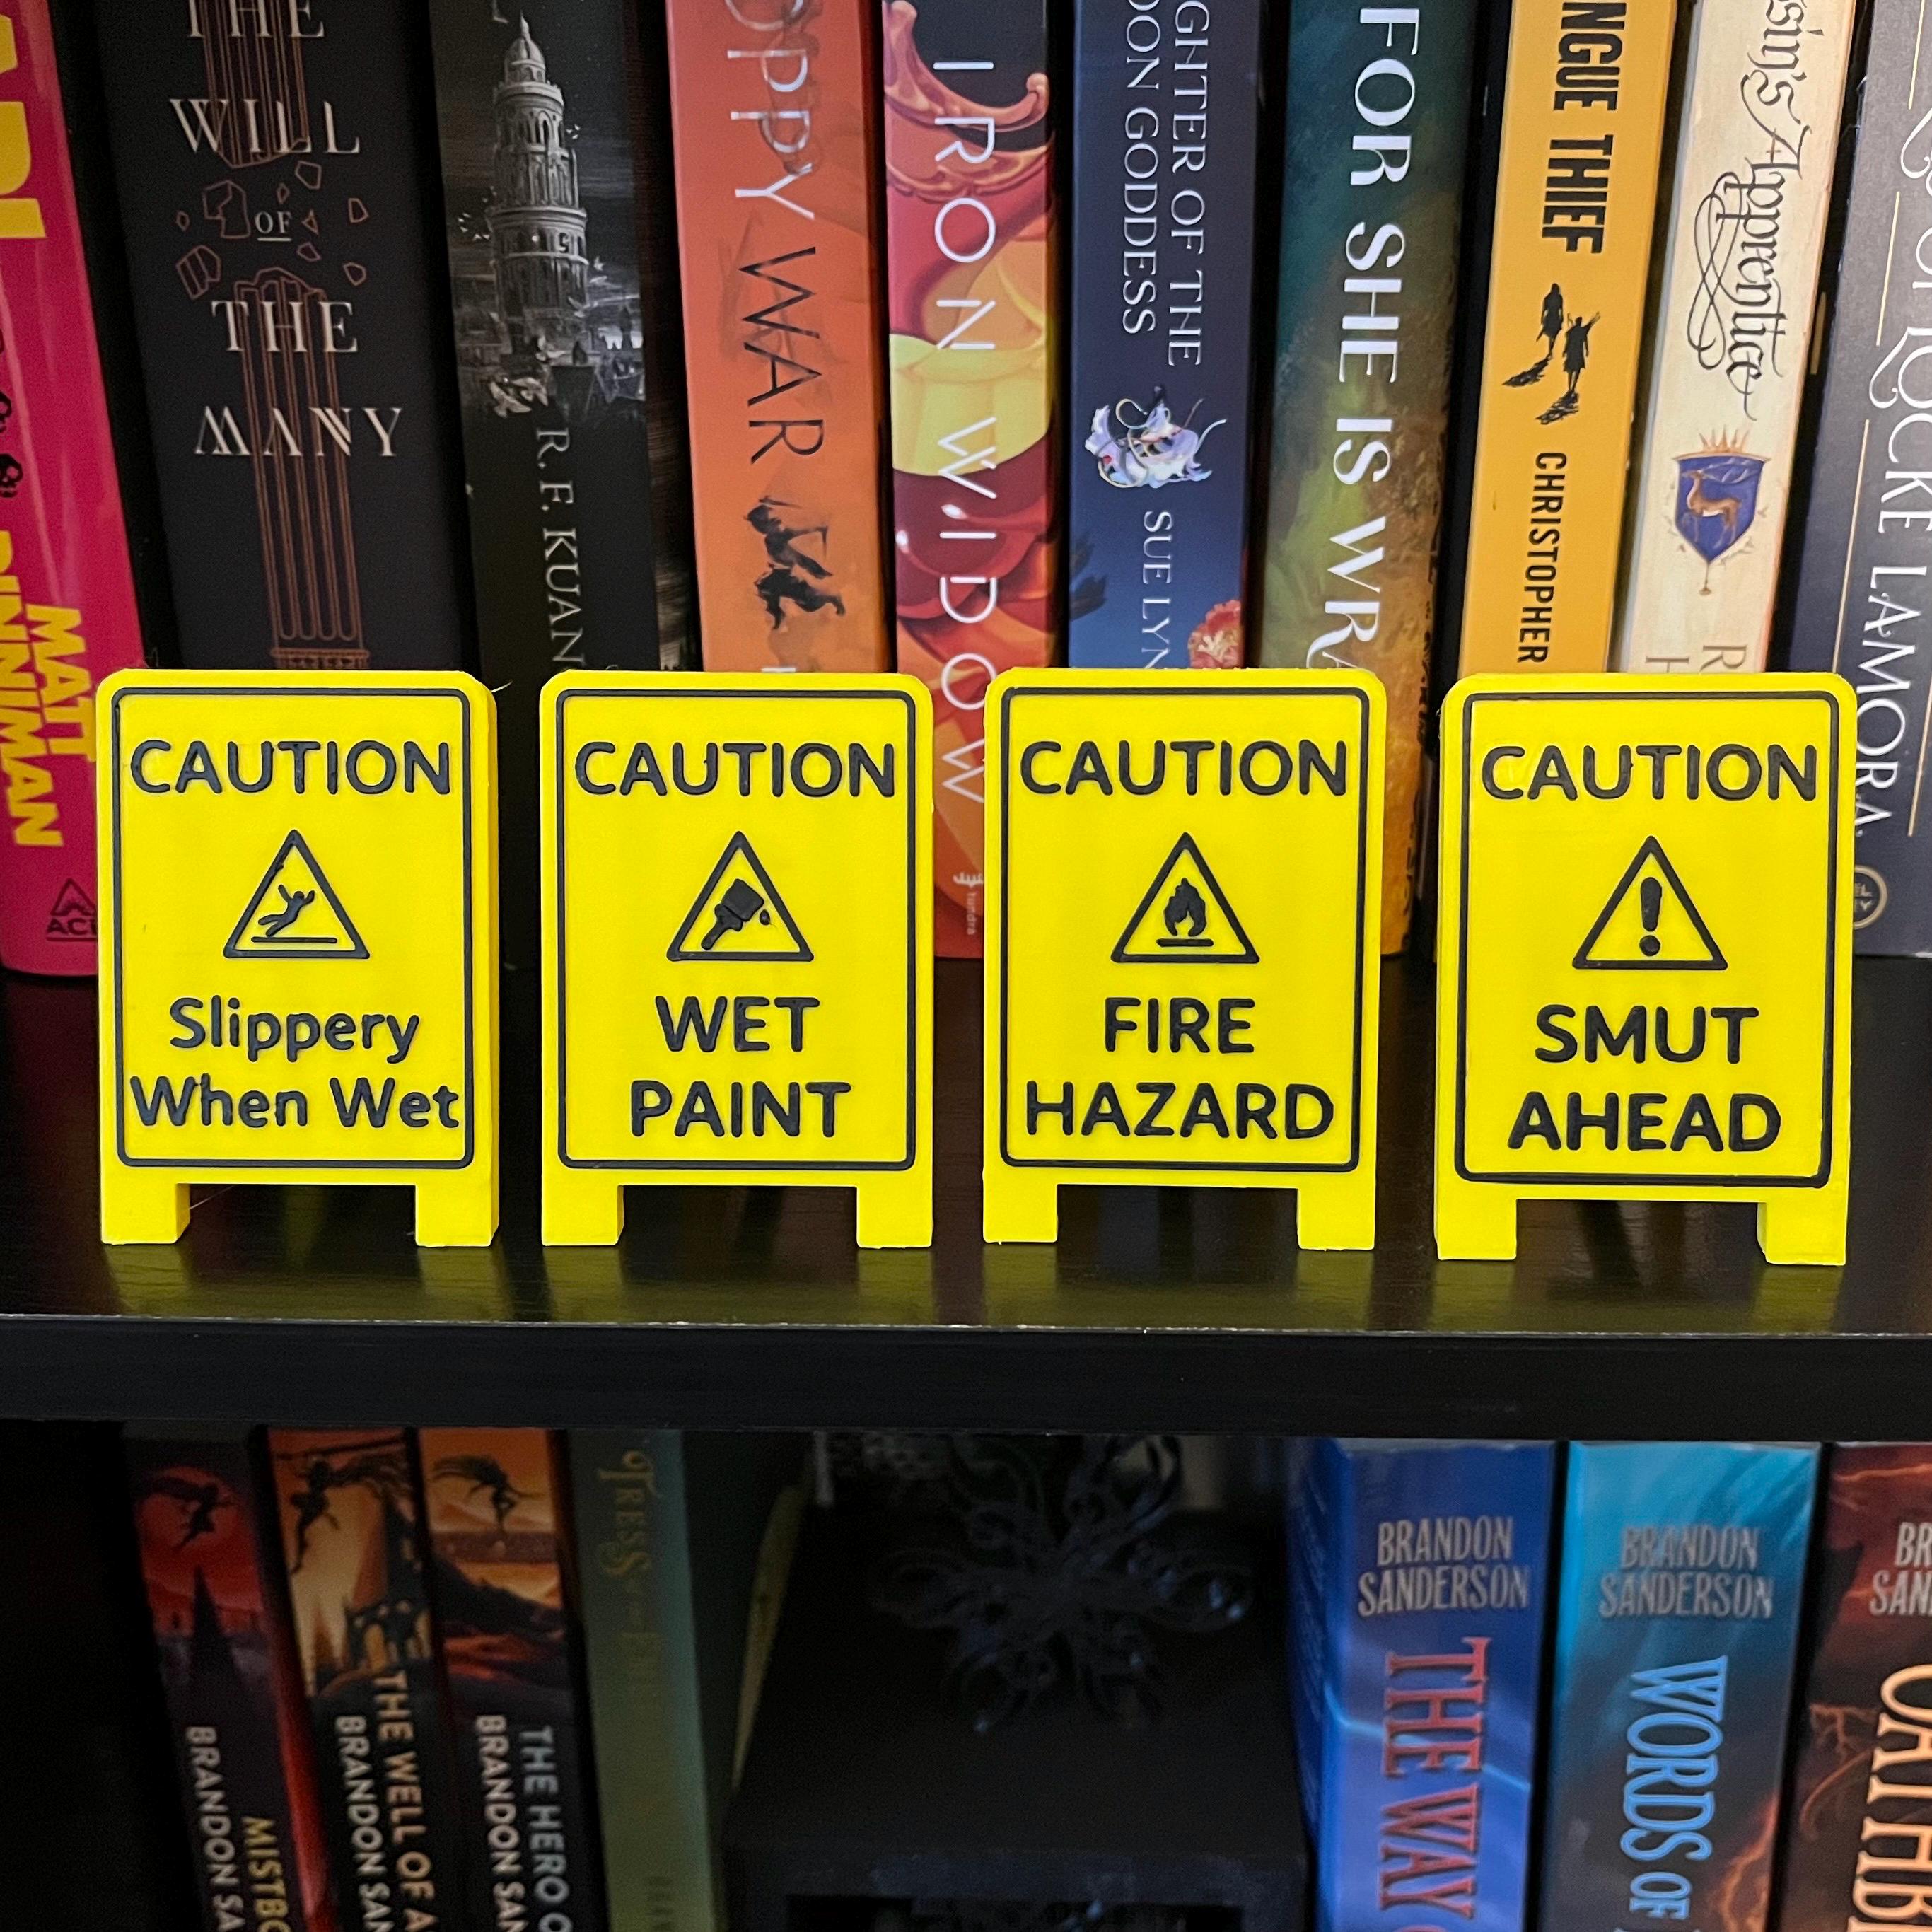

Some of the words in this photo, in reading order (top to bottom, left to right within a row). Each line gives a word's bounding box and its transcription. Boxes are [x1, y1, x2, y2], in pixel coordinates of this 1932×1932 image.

[190, 0, 325, 37] THE
[1126, 0, 1160, 89] ON
[1172, 1, 1210, 174] GHTER
[1553, 2, 1627, 111] NGUE
[1746, 0, 1825, 125] sin's
[170, 98, 360, 153] WILL
[1350, 8, 1420, 185] FOR
[255, 211, 291, 234] OF
[932, 61, 996, 350] IRON
[1122, 107, 1160, 334] GODDESS
[1170, 190, 1205, 255] OF
[1542, 134, 1614, 253] THIEF
[1687, 74, 1812, 421] Apprentice
[211, 301, 358, 352] THE
[1168, 269, 1203, 366] THE
[1338, 221, 1405, 383] SHE
[738, 246, 824, 465] WAR
[194, 405, 402, 457] MANY
[536, 429, 571, 470] R.
[1332, 418, 1393, 484] IS
[540, 481, 574, 512] F.
[1142, 510, 1173, 585] SUE
[1517, 451, 1567, 663] CHRISTOPHER
[542, 528, 586, 666] KUAN
[938, 417, 997, 803] WIDOW
[0, 530, 64, 847] NNIMAN
[26, 603, 96, 762] MATT
[1853, 566, 1928, 837] LAMORA
[130, 739, 451, 796] CAUTION
[574, 741, 895, 798] CAUTION
[1020, 739, 1347, 797] CAUTION
[1482, 743, 1817, 801] CAUTION
[169, 994, 420, 1064] Slippery
[655, 995, 820, 1053] WET
[1105, 996, 1256, 1054] FIRE
[1535, 1003, 1759, 1064] SMUT
[129, 1072, 308, 1129] When
[329, 1076, 460, 1129] Wet
[630, 1079, 852, 1138] PAINT
[1026, 1080, 1334, 1140] HAZARD
[1507, 1091, 1781, 1153] AHEAD
[1377, 1515, 1515, 1567] BRANDON
[1621, 1523, 1759, 1571] BRANDON
[1358, 1563, 1531, 1617] SANDERSON
[1598, 1570, 1774, 1619] SANDERSON
[375, 1670, 414, 1742] THE
[1383, 1636, 1492, 1778] THE
[519, 1726, 559, 1797] THE
[1619, 1655, 1729, 1861] WORDS
[185, 1726, 240, 1886] BRANDON
[335, 1716, 388, 1875] BRANDON
[385, 1751, 427, 1844] WELL
[475, 1715, 523, 1875] BRANDON
[396, 1851, 436, 1901] OF
[529, 1805, 570, 1904] HERO
[1378, 1782, 1479, 1920] WAY
[1629, 1871, 1692, 1921] OF
